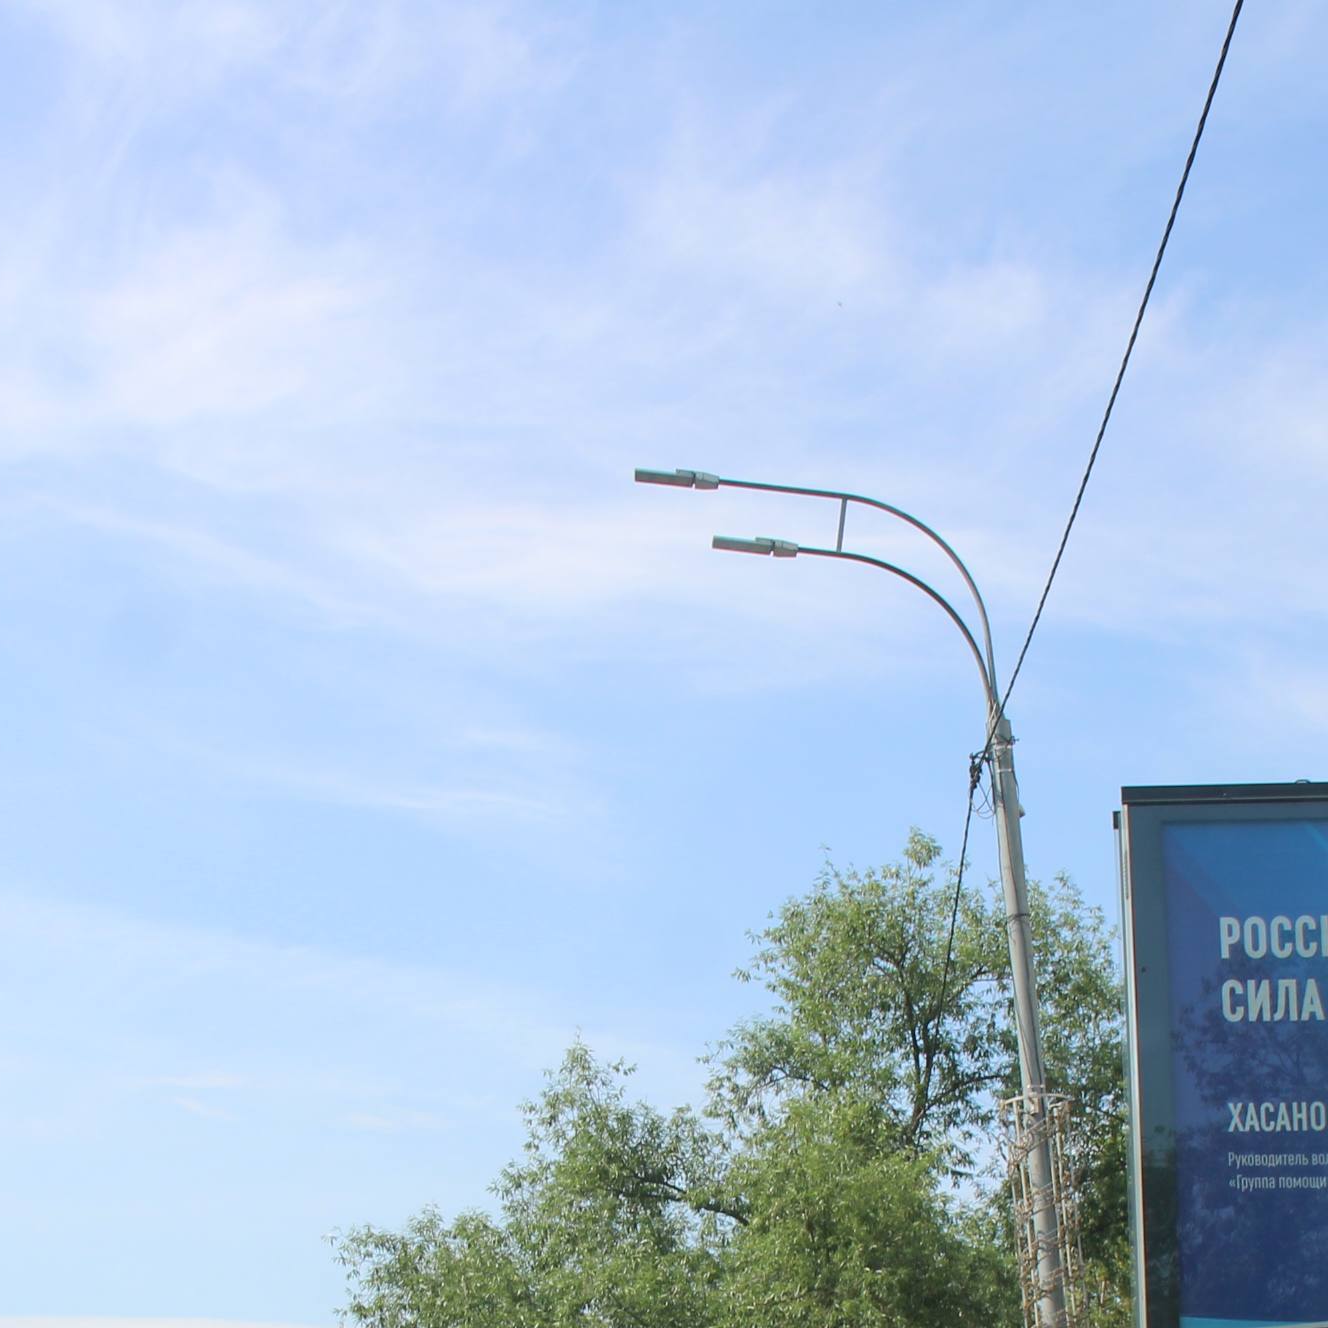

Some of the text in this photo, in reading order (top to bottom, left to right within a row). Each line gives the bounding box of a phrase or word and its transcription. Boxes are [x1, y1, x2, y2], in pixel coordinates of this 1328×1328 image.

[1222, 978, 1325, 1022] СИЛА
[1228, 1151, 1309, 1169] Руководитель
[1229, 1174, 1275, 1192] «Группа
[1278, 1175, 1327, 1190] помощи
